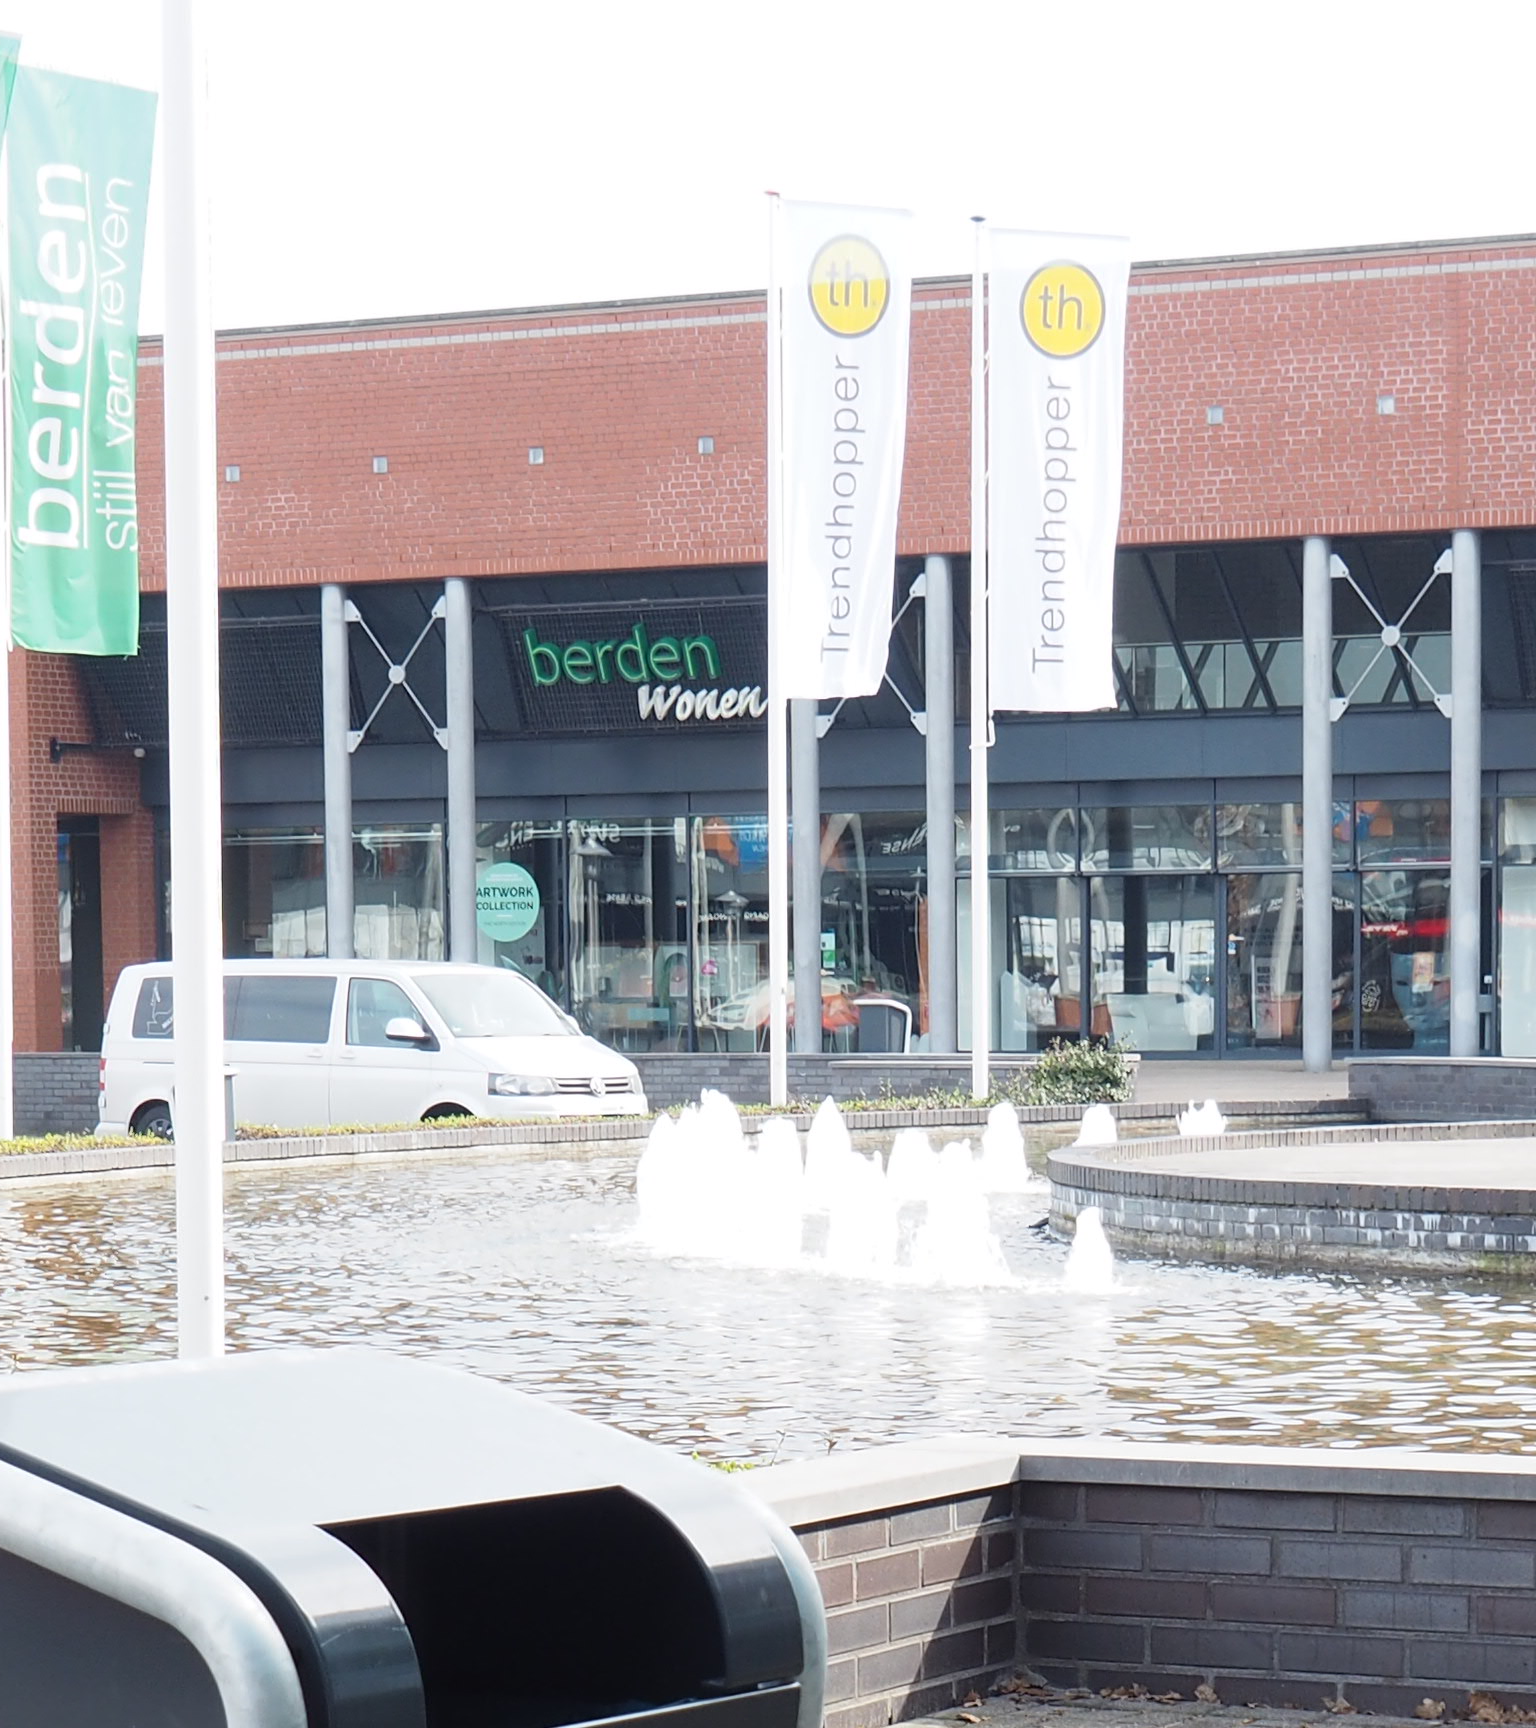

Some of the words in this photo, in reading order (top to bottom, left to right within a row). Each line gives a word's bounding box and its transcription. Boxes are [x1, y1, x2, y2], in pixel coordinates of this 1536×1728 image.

[100, 177, 134, 326] leven
[1038, 284, 1083, 330] th
[18, 163, 87, 548] berden
[105, 352, 133, 447] van
[820, 354, 866, 662] Trendhopper
[1032, 376, 1077, 673] Trendhopper
[523, 622, 722, 687] berden
[476, 886, 533, 898] ARTWORK
[476, 901, 534, 911] COLLECTION
